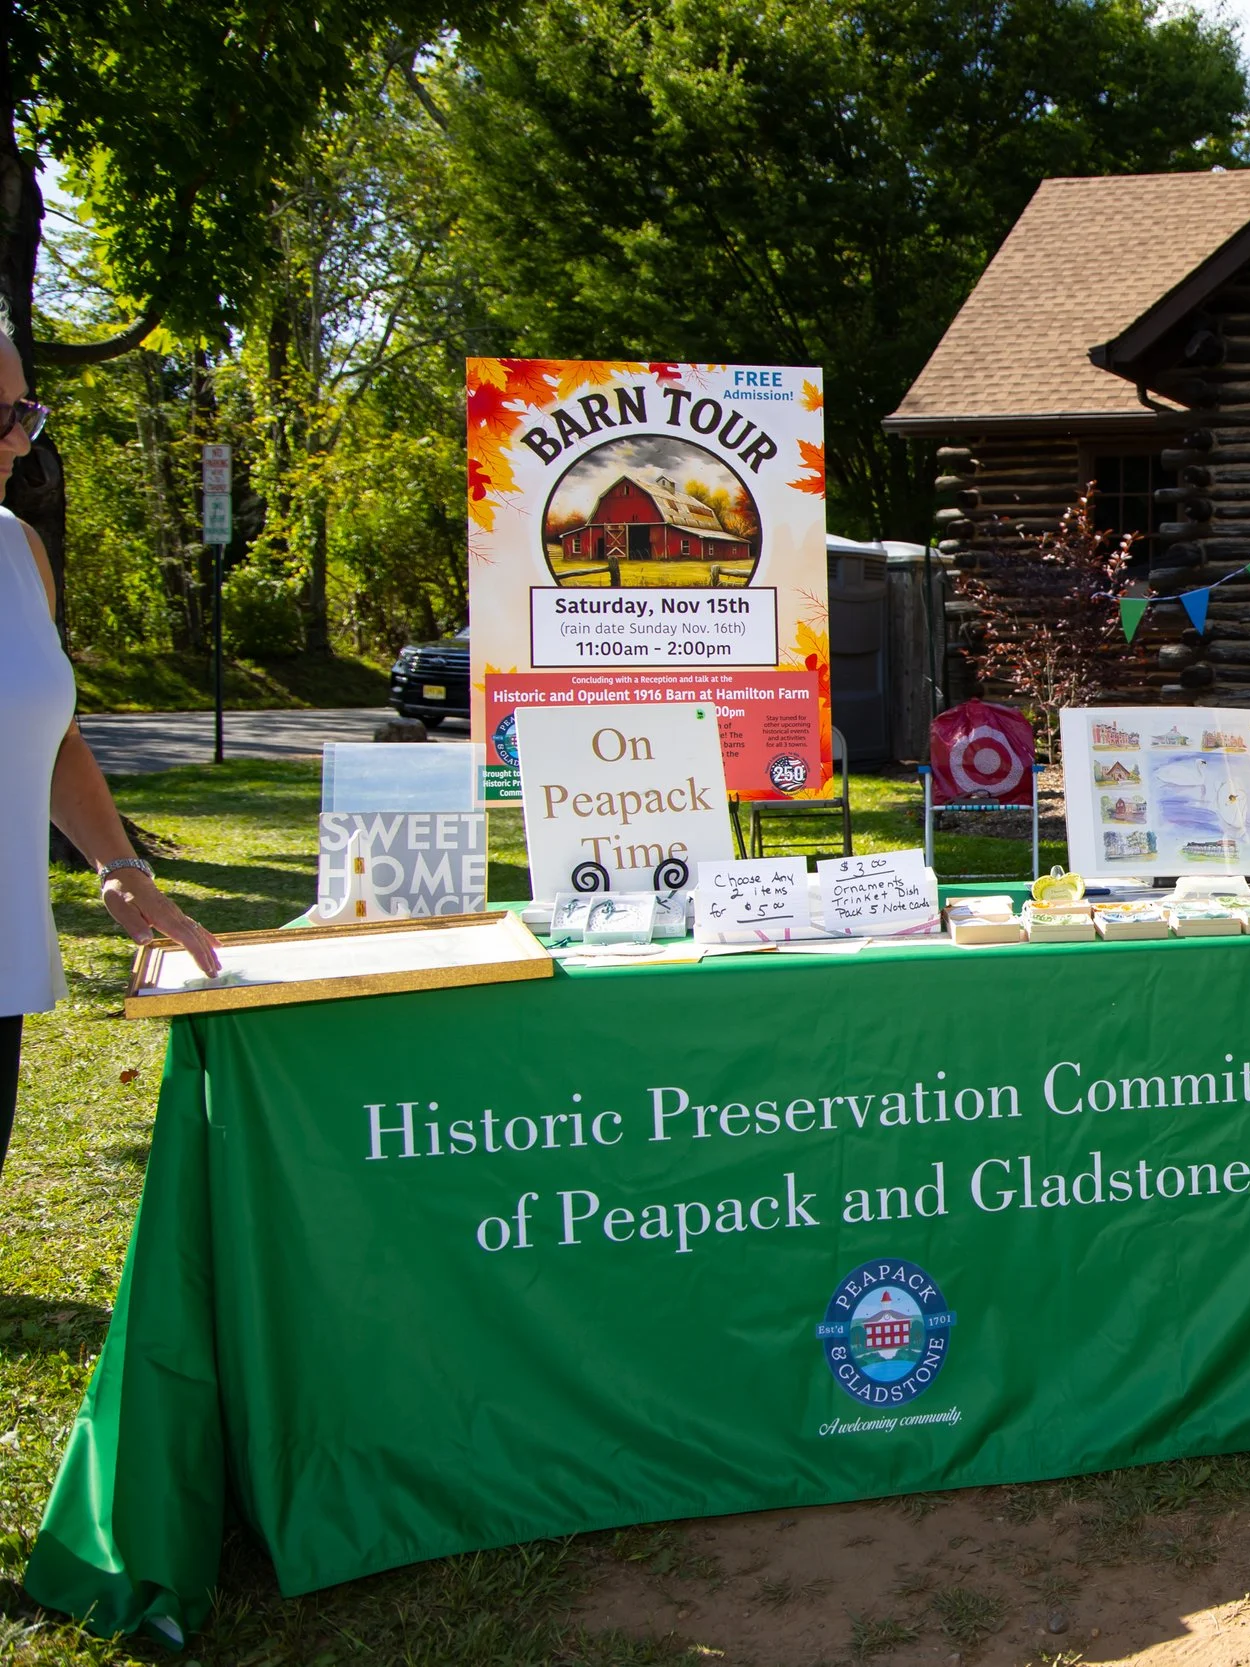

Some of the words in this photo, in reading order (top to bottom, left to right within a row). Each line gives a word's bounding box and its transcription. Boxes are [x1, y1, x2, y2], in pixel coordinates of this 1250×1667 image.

[734, 371, 782, 387] FREE
[723, 389, 793, 401] Admission!
[520, 386, 648, 466] BARN
[663, 388, 777, 474] TOUR
[555, 598, 653, 617] Saturday,
[662, 599, 700, 613] Nov
[707, 599, 749, 613] 15th
[561, 622, 590, 637] (rain
[596, 623, 624, 634] date
[630, 623, 677, 636] Sunday
[683, 623, 709, 634] Nov.
[714, 622, 745, 636] 16th)
[577, 642, 648, 656] 11:00am
[668, 641, 731, 658] 2:00pm
[572, 676, 613, 685] Concluding
[641, 676, 676, 685] Reception
[494, 690, 546, 702] Historic
[550, 690, 574, 702] and
[578, 689, 630, 704] Opulent
[634, 689, 661, 700] 1916
[666, 688, 695, 700] Barn
[700, 689, 712, 700] at
[716, 688, 774, 700] Hamilton
[779, 688, 809, 699] Farm
[715, 706, 744, 718] 00pm
[592, 728, 655, 763] On
[483, 771, 511, 779] Brought
[774, 766, 803, 781] 250
[540, 777, 714, 826] Peapack
[321, 813, 484, 852] SWEET
[581, 835, 688, 872] Time
[320, 852, 485, 896] HOME
[715, 874, 762, 887] Choose
[772, 872, 795, 885] Any
[731, 888, 743, 899] 2
[754, 886, 787, 896] items
[834, 878, 904, 896] Ornaments
[832, 892, 887, 906] Trinket
[898, 887, 919, 898] Dish
[710, 904, 726, 917] for
[835, 907, 862, 919] Pack
[870, 905, 878, 914] 5
[883, 903, 906, 913] Note
[364, 1093, 624, 1162] Historic
[647, 1071, 1021, 1142] Preservation
[476, 1191, 539, 1253] of
[558, 1172, 819, 1253] Peapack
[842, 1162, 949, 1223] and
[970, 1150, 1250, 1214] Gladstone
[836, 1265, 936, 1310] PEAPACK
[818, 1325, 843, 1334] Est'd
[929, 1315, 950, 1326] 1701
[839, 1338, 944, 1402] GLADSTONE
[819, 1418, 839, 1436] A
[839, 1416, 896, 1433] welcoming
[900, 1406, 962, 1425] community.
